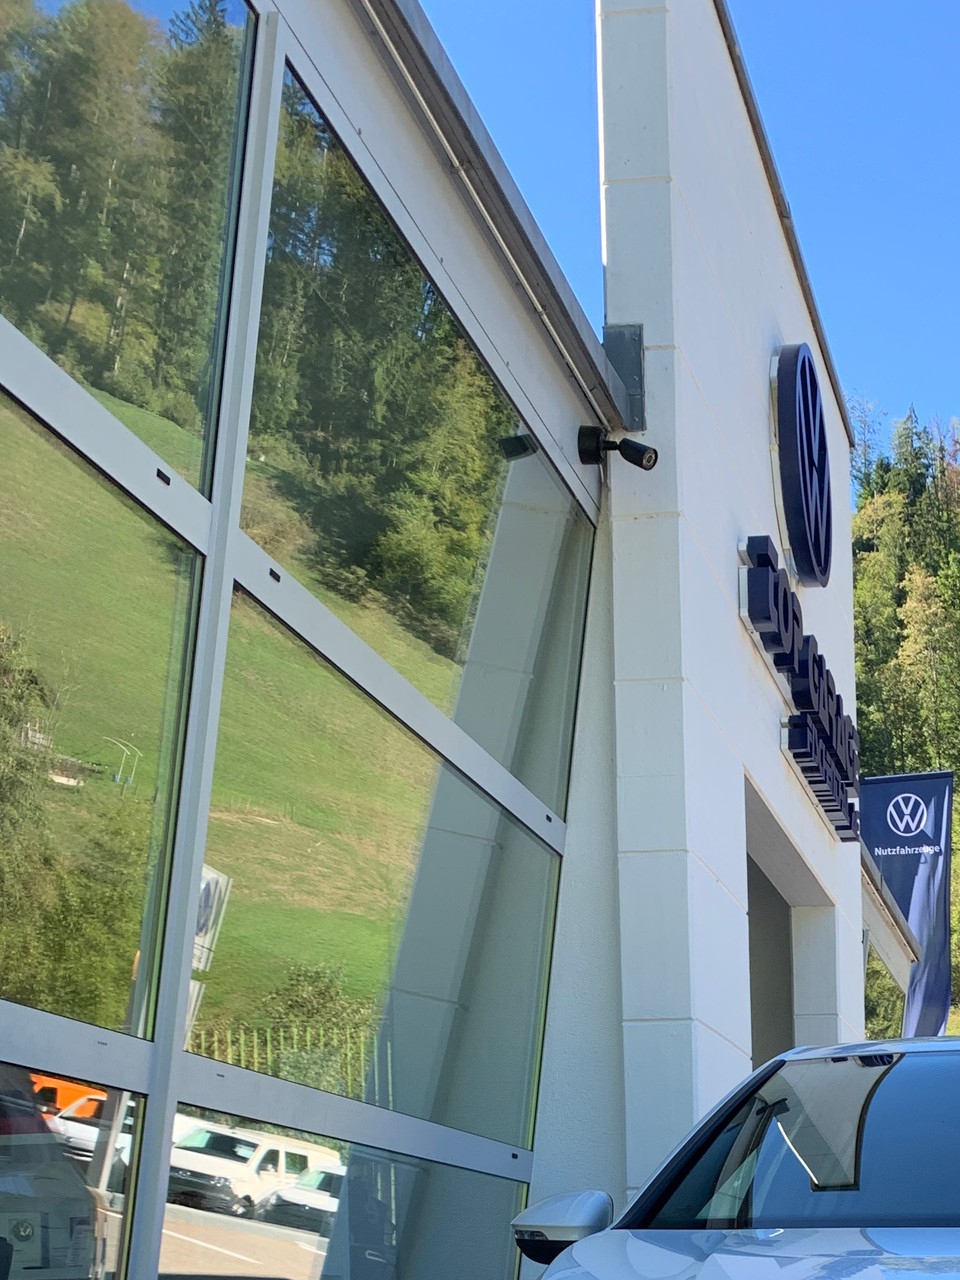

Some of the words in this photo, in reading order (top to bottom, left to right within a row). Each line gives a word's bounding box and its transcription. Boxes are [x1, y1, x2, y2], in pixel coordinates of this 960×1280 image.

[747, 534, 804, 674] TOP
[793, 634, 860, 799] GARAGE
[874, 845, 940, 856] Nutzfahrzeuge
